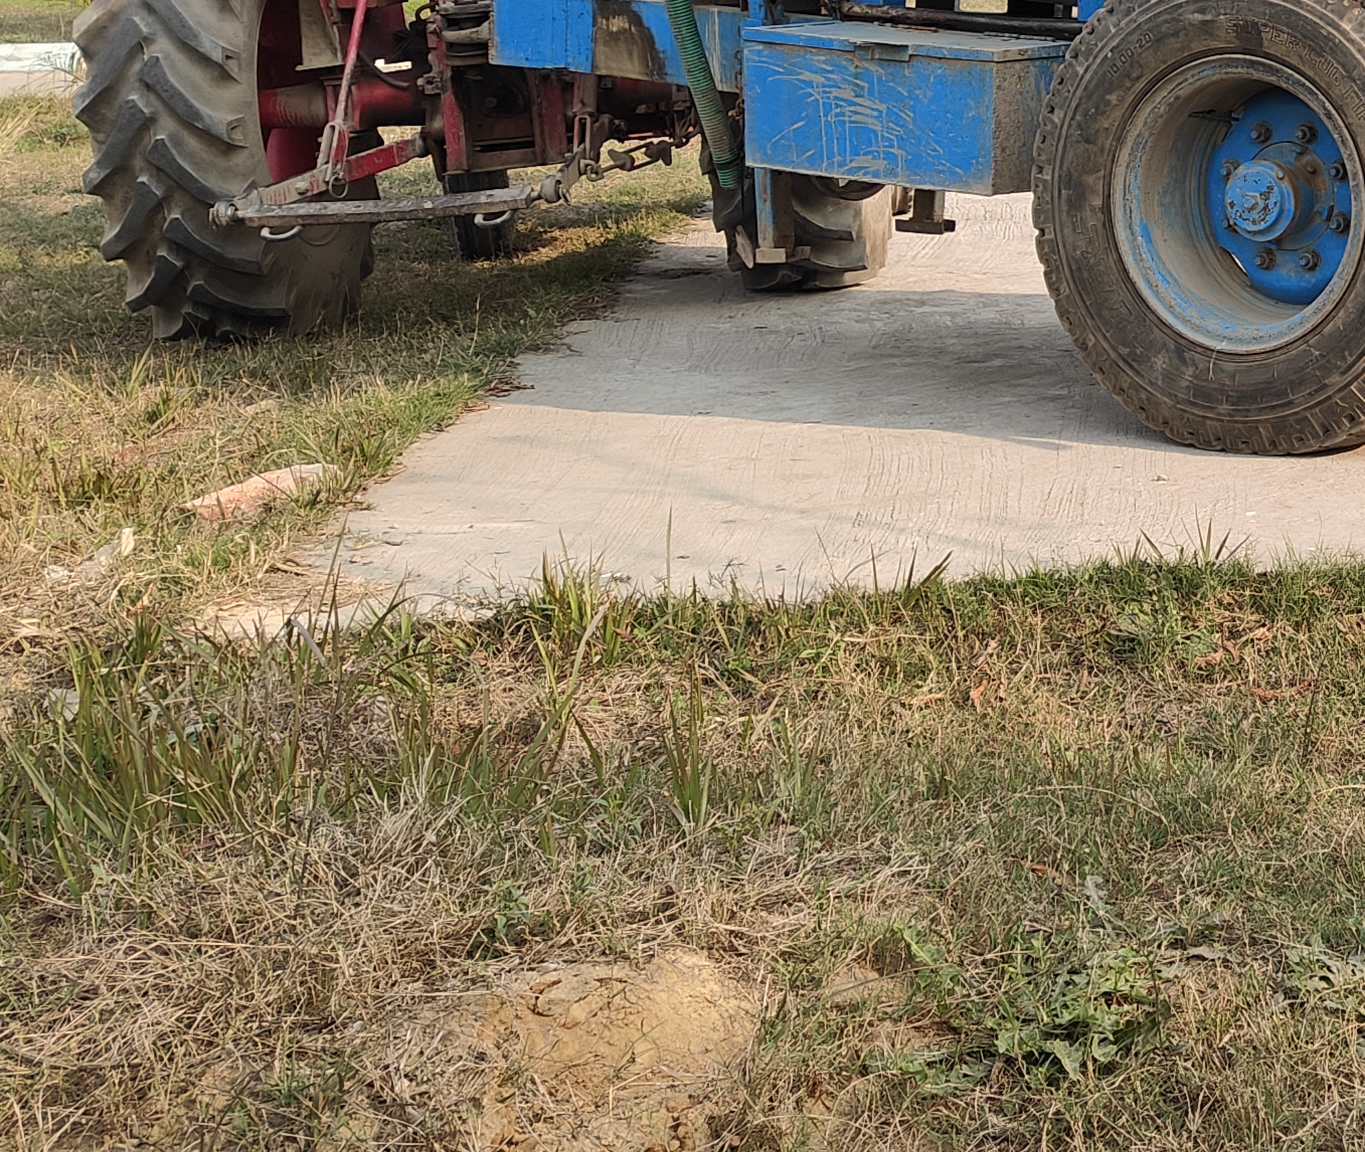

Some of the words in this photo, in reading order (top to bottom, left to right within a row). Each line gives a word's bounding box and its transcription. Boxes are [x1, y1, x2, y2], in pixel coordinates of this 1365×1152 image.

[1107, 32, 1152, 78] 10.00-20
[1225, 15, 1300, 50] SUPER
[1303, 44, 1345, 87] LUG
